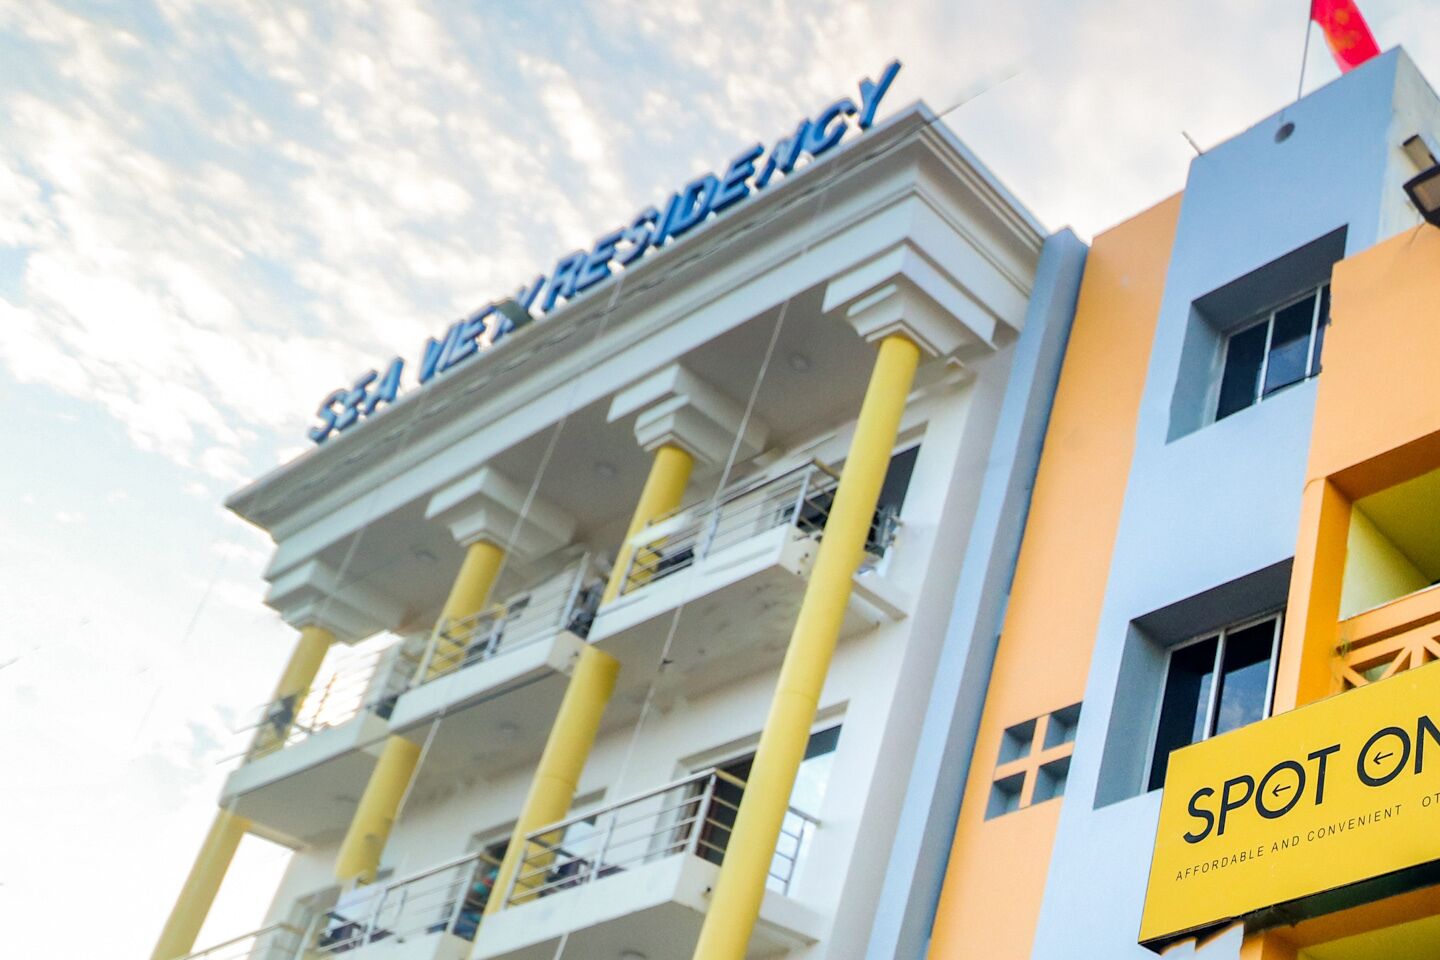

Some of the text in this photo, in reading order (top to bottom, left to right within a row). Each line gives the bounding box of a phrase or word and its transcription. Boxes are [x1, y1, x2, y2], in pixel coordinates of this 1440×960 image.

[308, 356, 405, 446] SEA
[542, 59, 902, 311] RESIDENCY
[1175, 846, 1265, 882] AFFORDABLE
[1271, 835, 1300, 853] AND
[1307, 804, 1403, 842] CONVENIENT
[1182, 744, 1341, 844] SPOT
